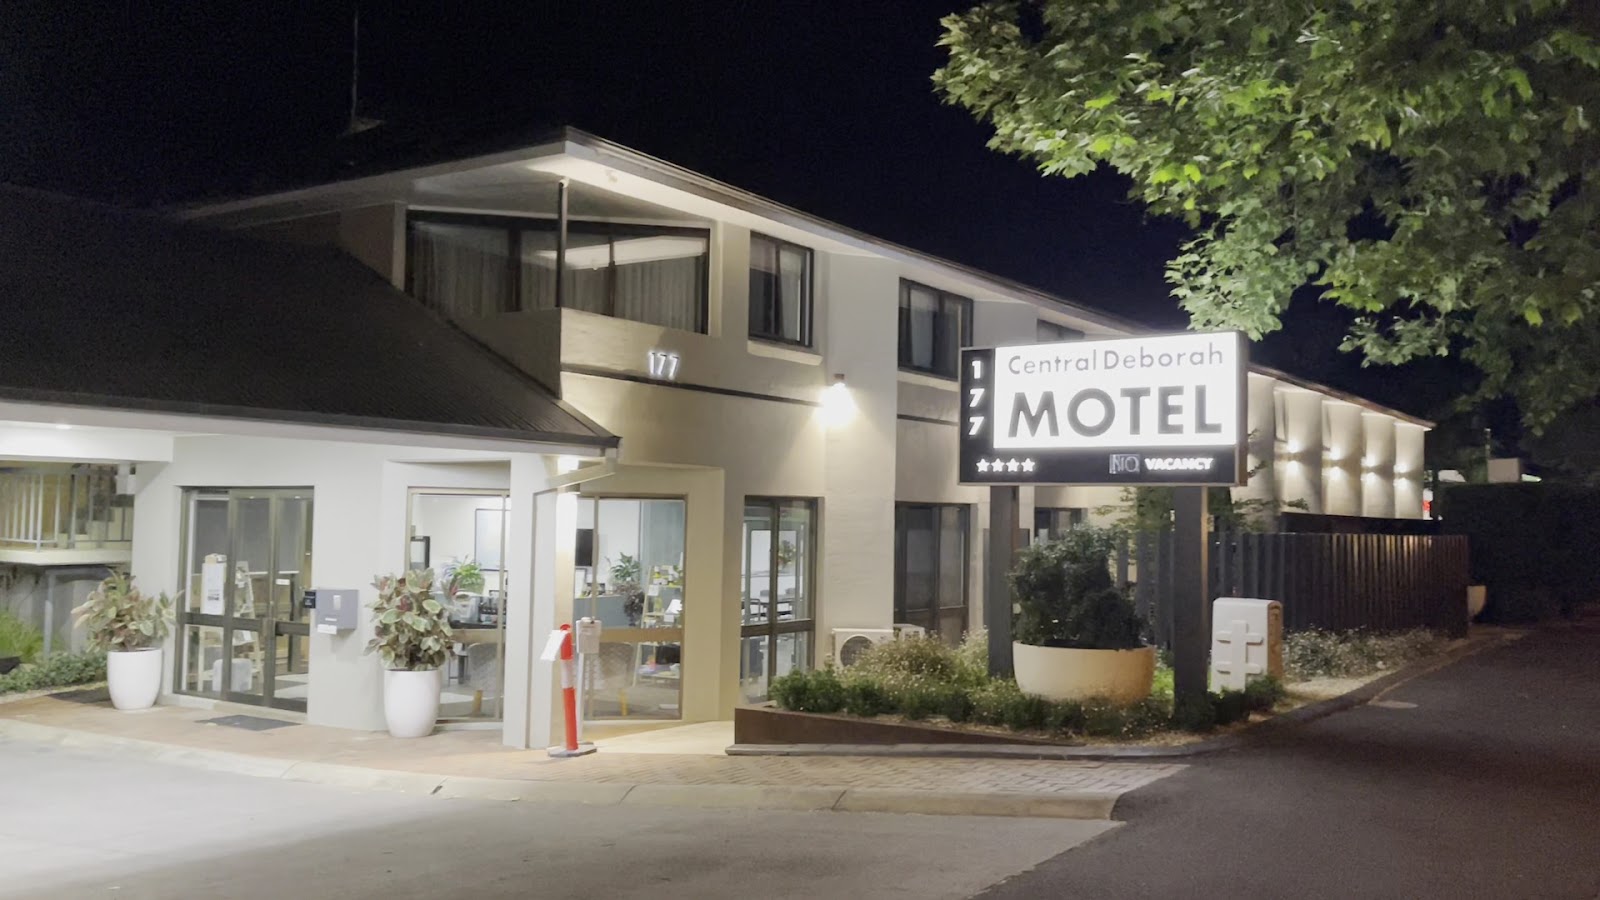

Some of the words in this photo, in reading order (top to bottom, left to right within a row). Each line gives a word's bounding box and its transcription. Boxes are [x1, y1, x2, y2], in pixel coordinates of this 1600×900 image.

[649, 351, 679, 379] 177
[1008, 349, 1097, 374] Central
[1104, 343, 1223, 370] Deborah
[1008, 385, 1222, 437] MOTEL
[1144, 457, 1214, 471] VACANCY
